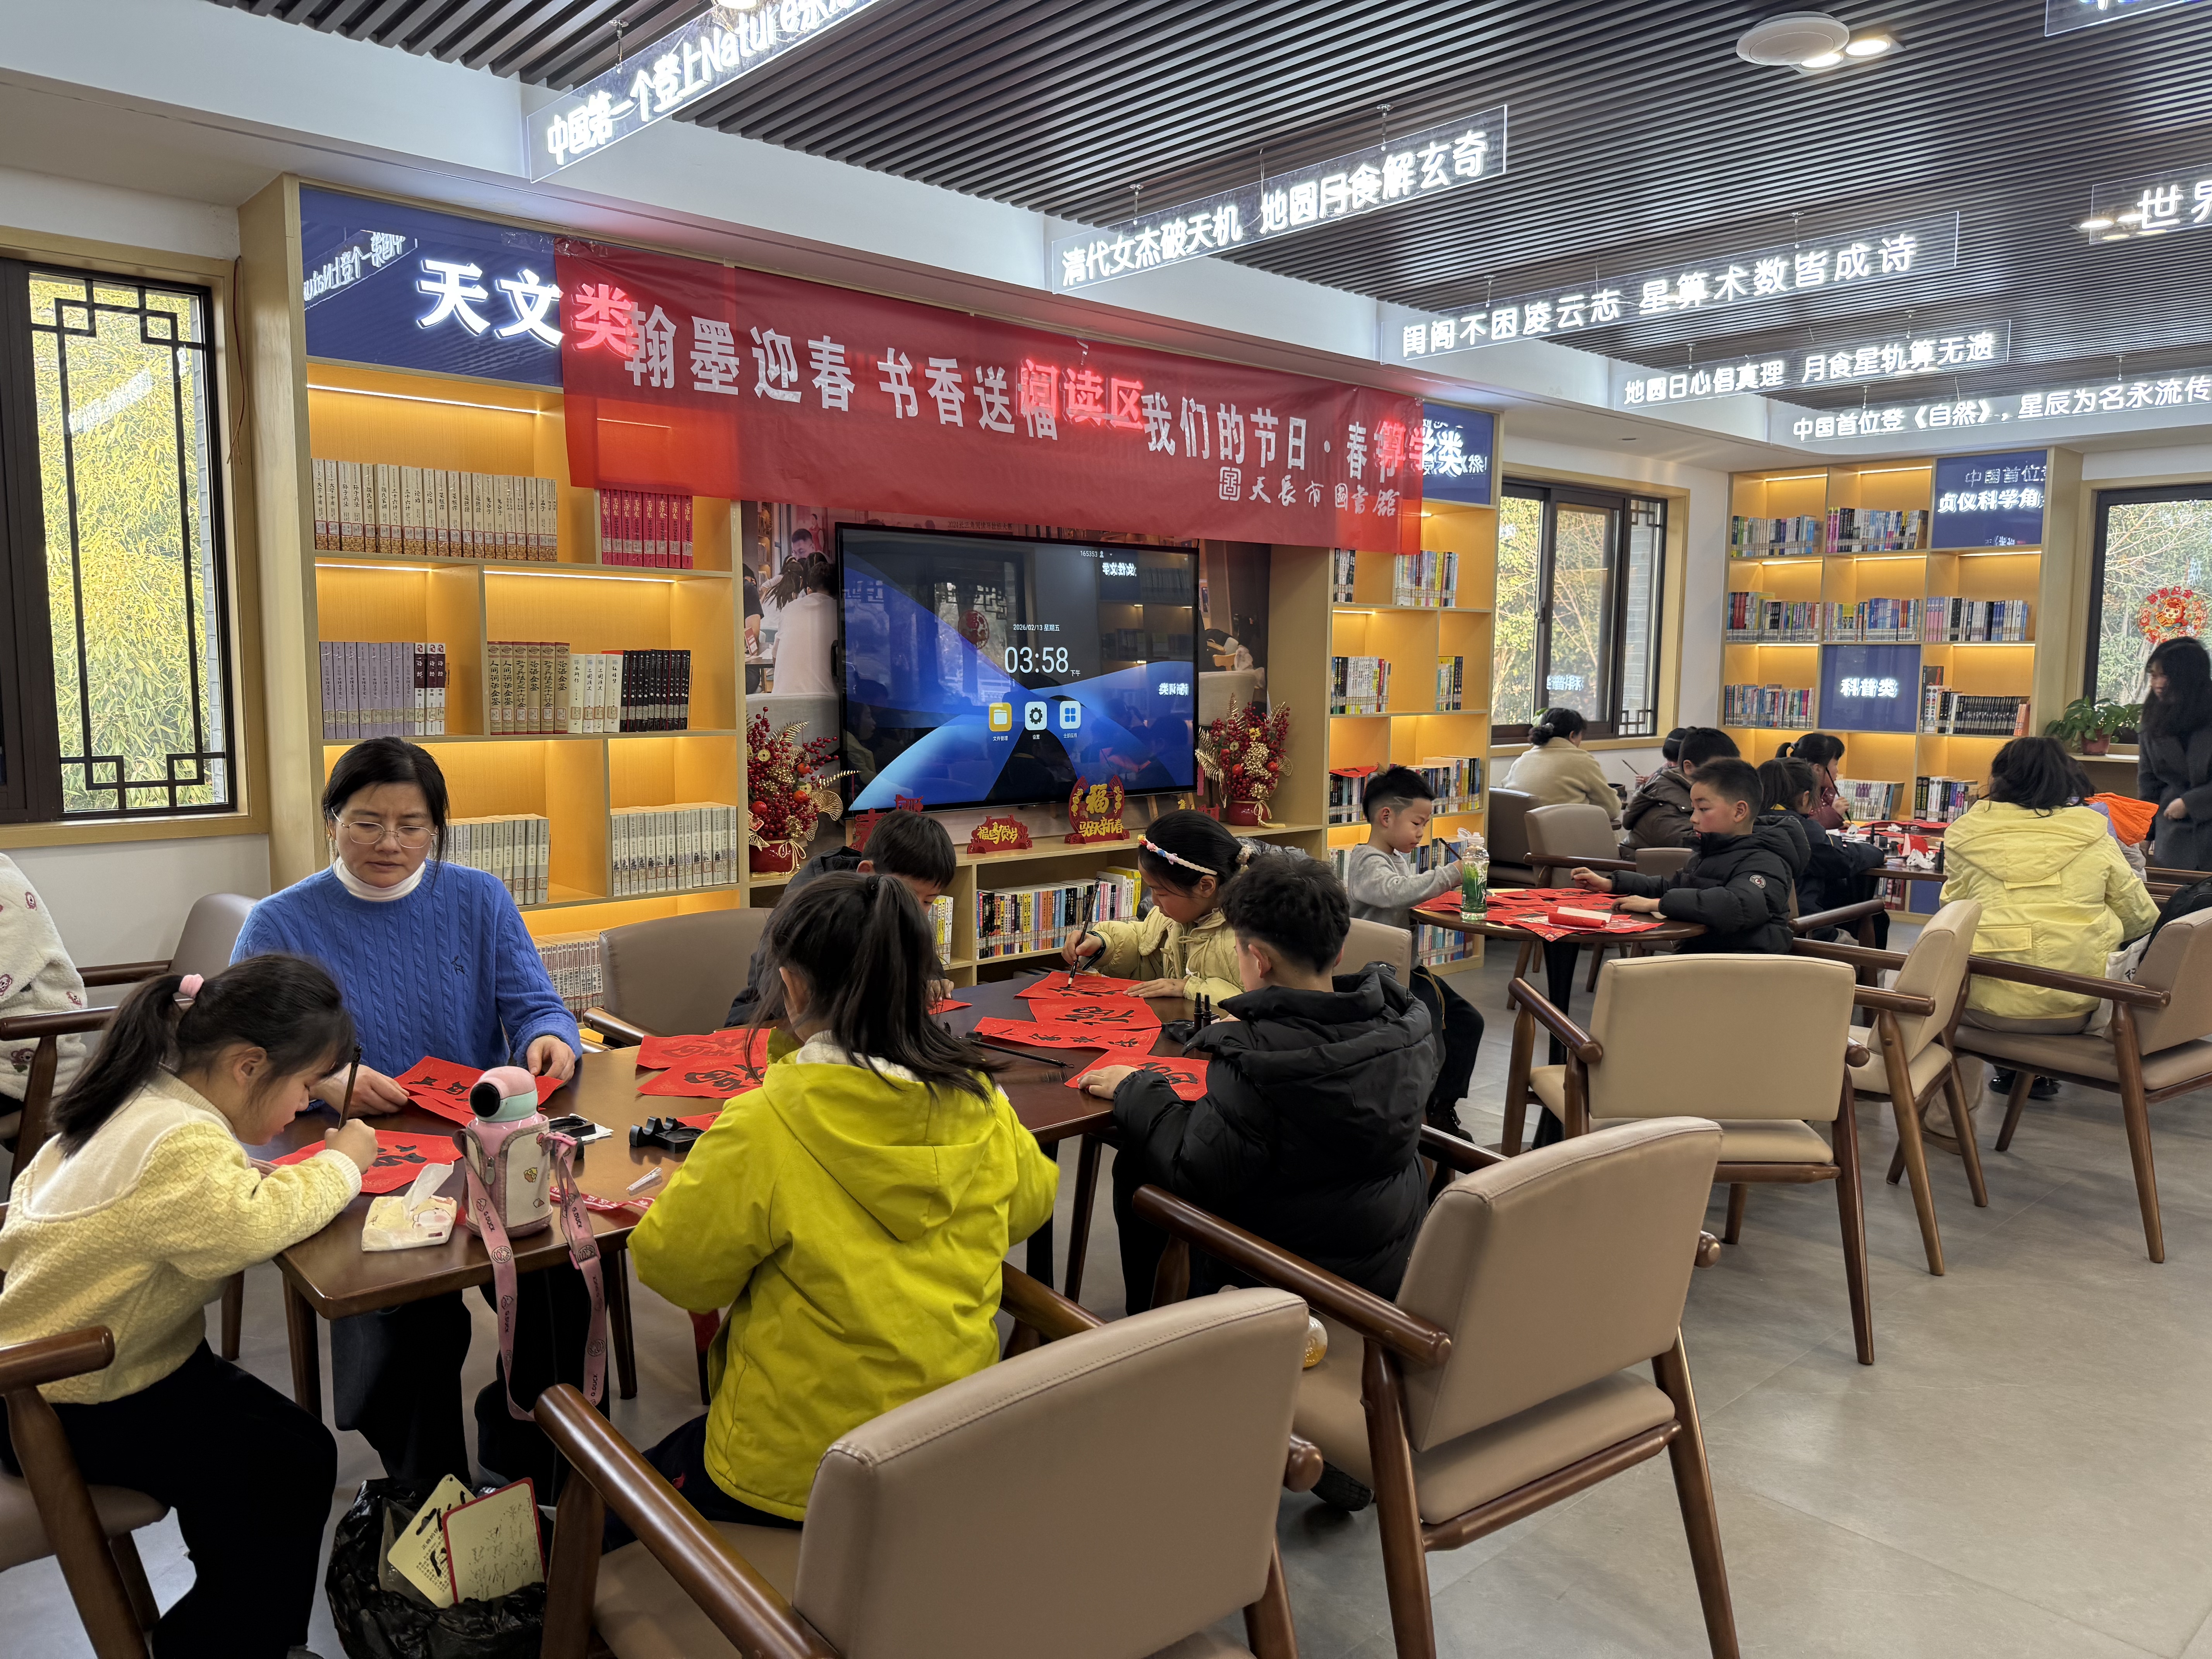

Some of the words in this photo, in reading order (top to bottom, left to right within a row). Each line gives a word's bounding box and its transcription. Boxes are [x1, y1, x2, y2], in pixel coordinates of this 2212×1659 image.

[1062, 205, 1242, 287] 清代女杰破天机
[1259, 130, 1486, 235] 地圆月食解玄奇
[1402, 293, 1622, 357] 闺阁不困凌云志
[1638, 231, 1916, 318] 星算术数皆成诗
[624, 302, 855, 412] 翰墨迎春
[878, 347, 1058, 440] 书香送福
[1801, 331, 1994, 383] 月食星轨算无遗
[1937, 487, 2040, 513] 贞仪科学角
[1005, 646, 1069, 673] 03:58
[1840, 678, 1899, 697] 科普类
[1086, 784, 1109, 814] 福
